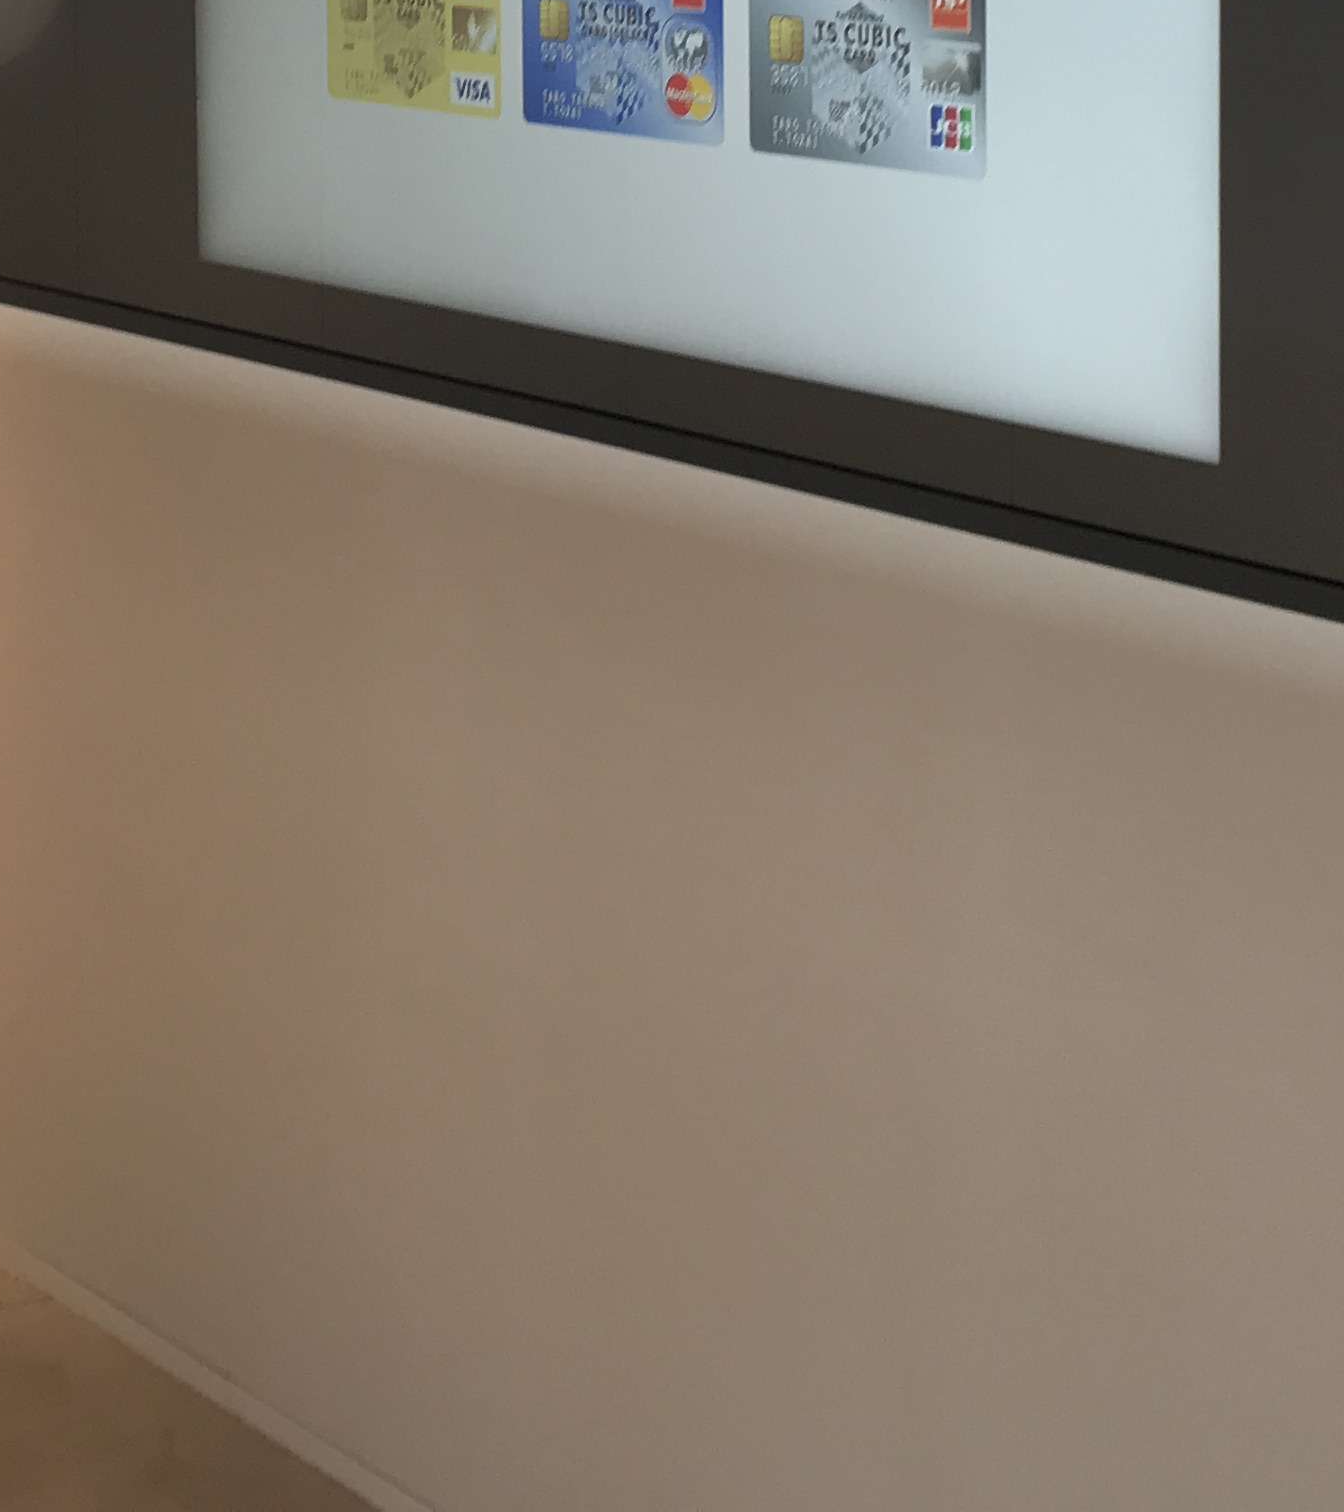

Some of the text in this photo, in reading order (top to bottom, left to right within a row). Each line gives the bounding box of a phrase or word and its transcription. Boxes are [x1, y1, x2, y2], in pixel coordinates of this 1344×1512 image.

[602, 2, 657, 28] CUBIC
[843, 22, 907, 50] CUBIC
[455, 77, 492, 103] VISA
